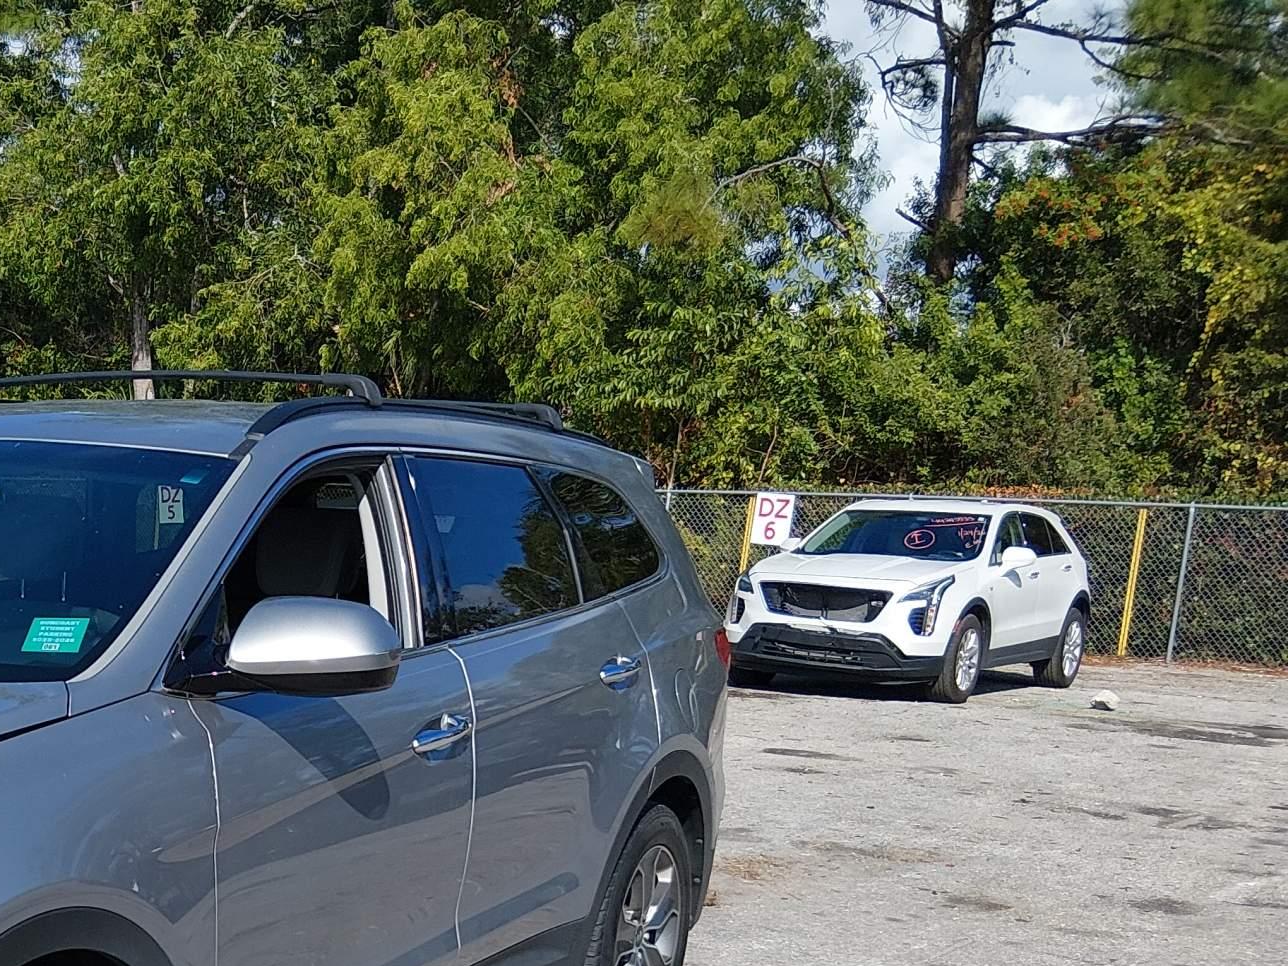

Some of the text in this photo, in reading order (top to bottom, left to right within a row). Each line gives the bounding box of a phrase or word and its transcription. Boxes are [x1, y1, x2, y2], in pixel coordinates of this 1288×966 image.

[160, 486, 181, 503] DZ
[167, 505, 176, 520] 5
[758, 497, 790, 518] DZ
[764, 521, 776, 540] 6
